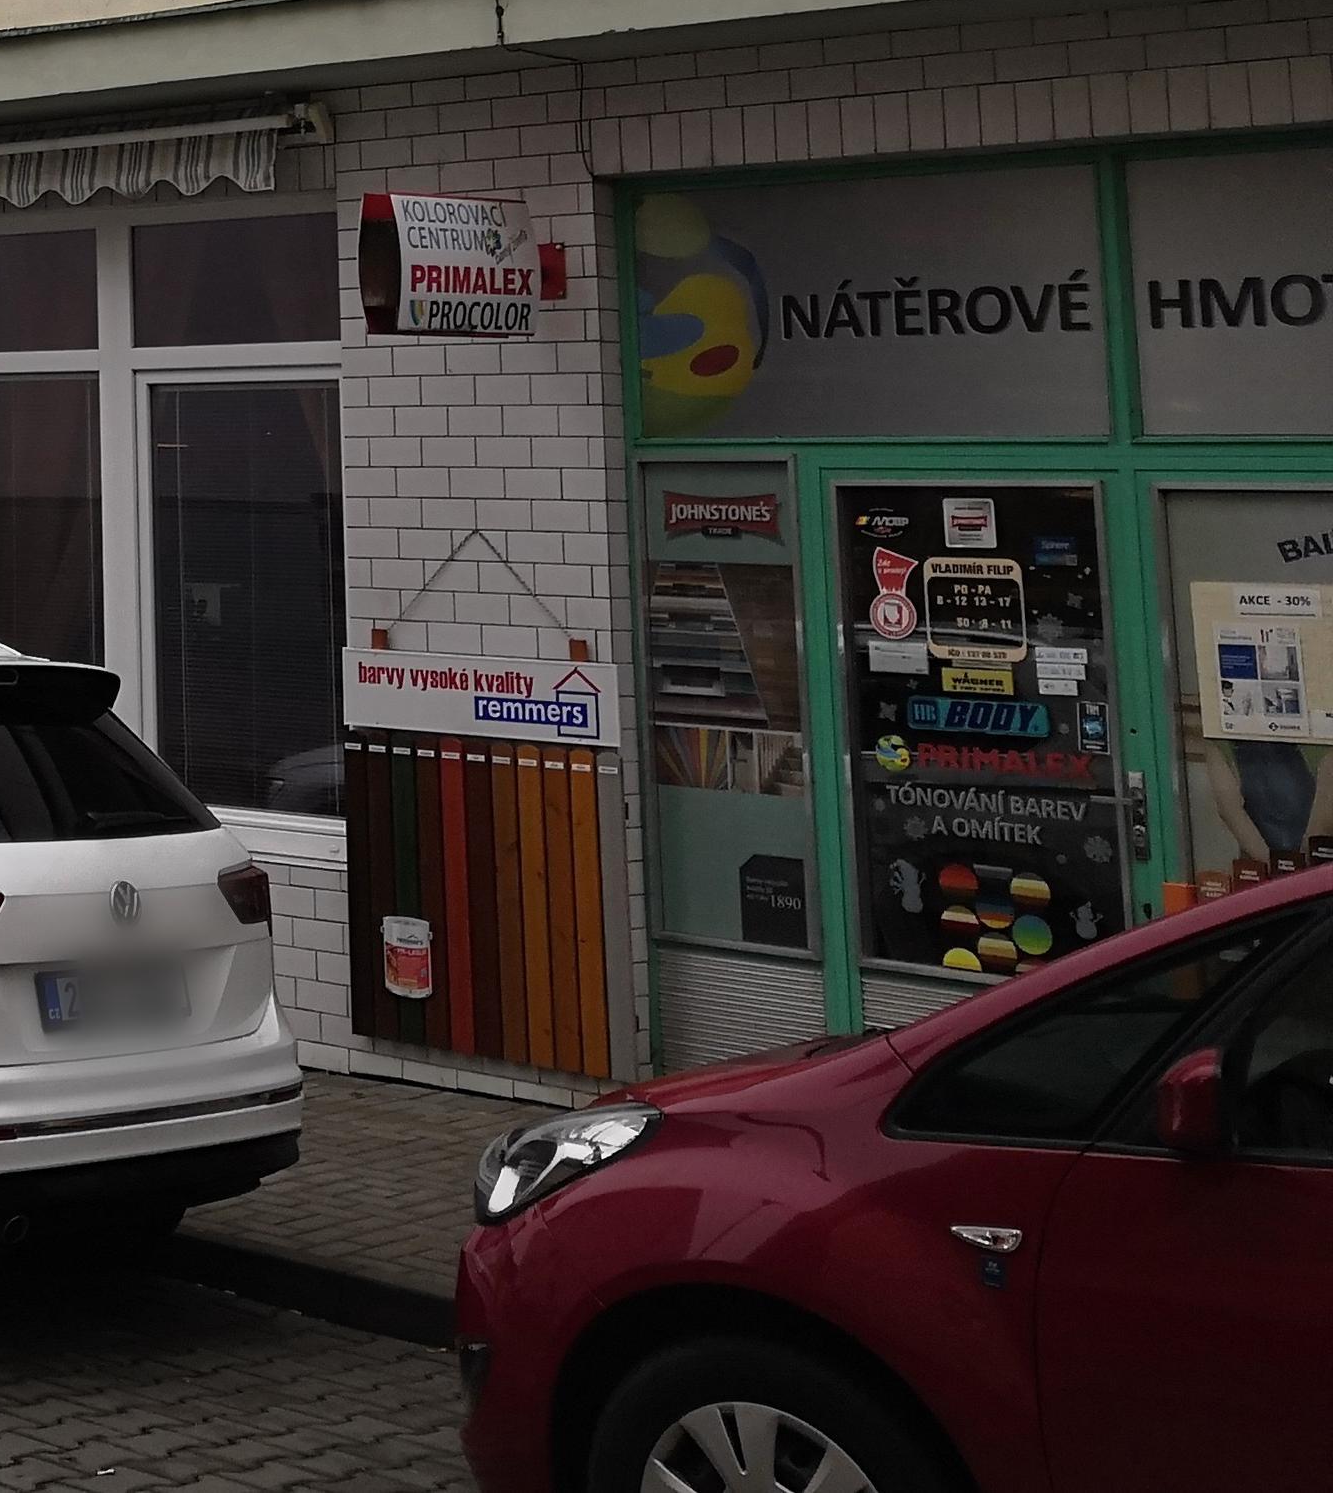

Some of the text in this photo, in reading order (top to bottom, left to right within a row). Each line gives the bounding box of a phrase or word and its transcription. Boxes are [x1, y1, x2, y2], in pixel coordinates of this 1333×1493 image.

[401, 199, 507, 228] KOLOROVACÍ
[410, 264, 534, 296] PRIMALEX
[427, 300, 531, 331] PROCOLOR
[781, 269, 1092, 340] NÁTĚROVÉ
[669, 501, 771, 524] JOHNSTONE'S
[1277, 529, 1333, 563] BAL
[931, 561, 1014, 576] VLADIMÍR FILIP
[954, 596, 967, 606] 12
[998, 597, 1011, 607] 17
[978, 584, 992, 596] PA
[1239, 595, 1271, 606] AKCE
[1285, 596, 1311, 607] 30%
[358, 661, 534, 699] barvy vysoké kvality
[951, 677, 1004, 687] WAGNER
[478, 697, 583, 725] remmers
[944, 701, 1039, 732] BODY
[917, 743, 1093, 780] PRIMALEX
[886, 781, 1087, 821] TÓNOVÁNÍ BAREV
[931, 815, 1043, 845] A OMÍTEK
[771, 894, 802, 910] 1890
[48, 1007, 61, 1020] CZ
